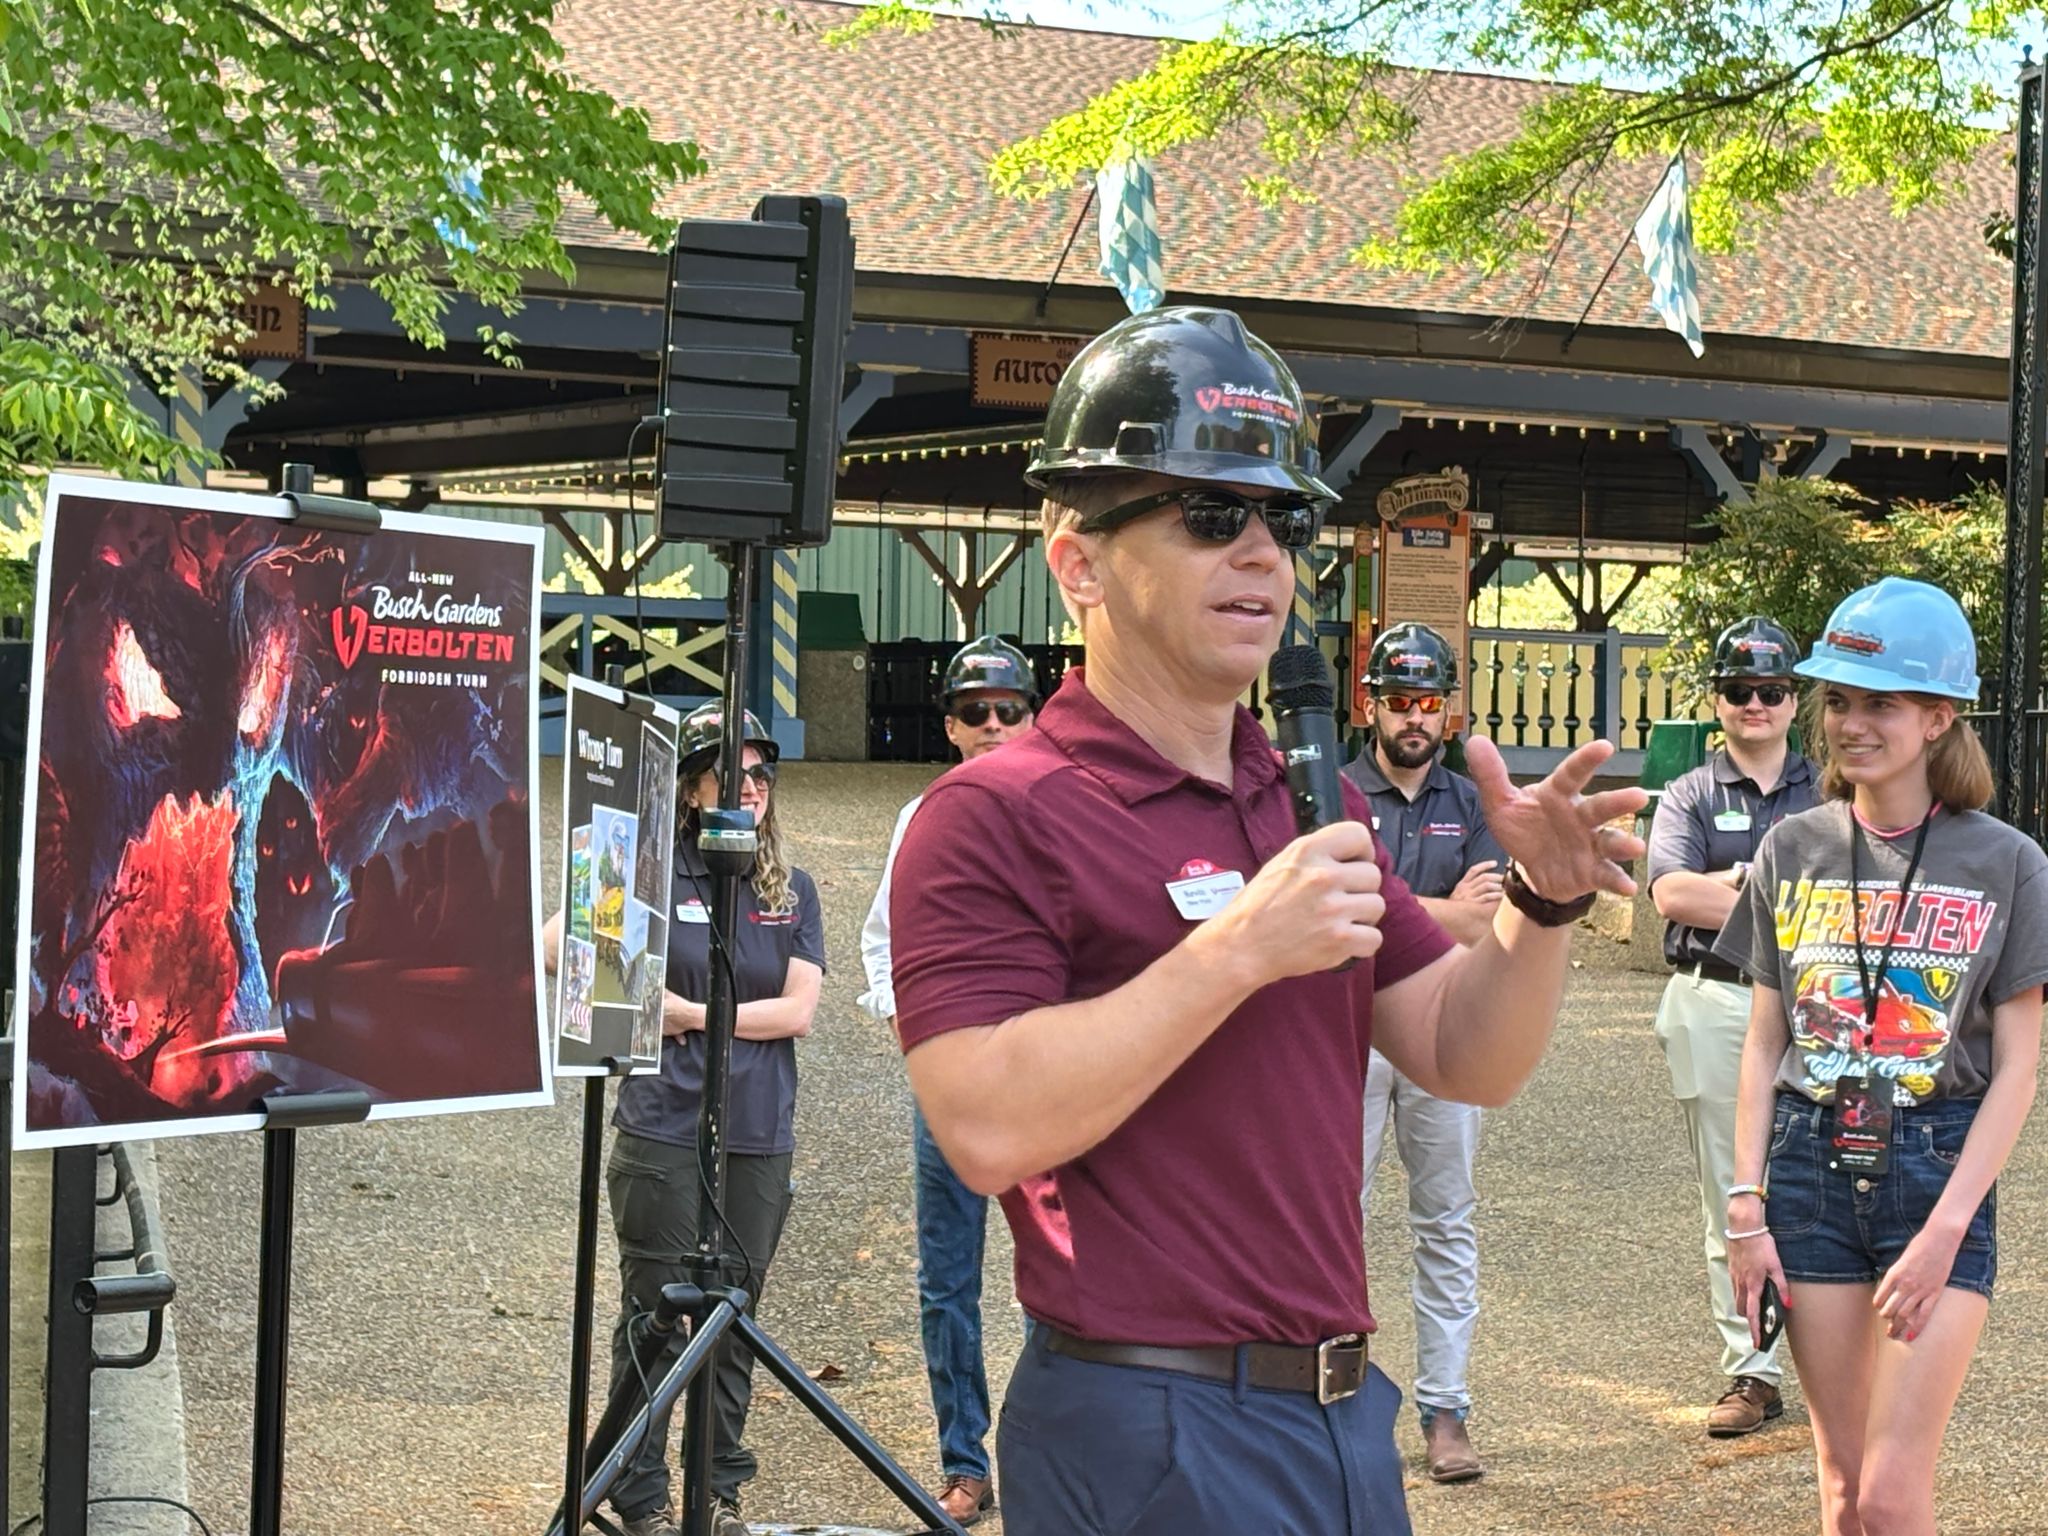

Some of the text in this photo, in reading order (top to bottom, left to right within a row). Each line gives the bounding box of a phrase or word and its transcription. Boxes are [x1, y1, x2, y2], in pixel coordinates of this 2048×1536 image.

[993, 359, 1063, 386] AUTO
[408, 570, 454, 586] ALL-NEW
[371, 585, 503, 627] Busch Gardens
[332, 605, 515, 670] VERBOLTEN
[381, 668, 488, 688] FORBIDDEN TURN
[577, 728, 623, 770] Wrong Turn
[1774, 879, 1997, 954] VERBOLTEN
